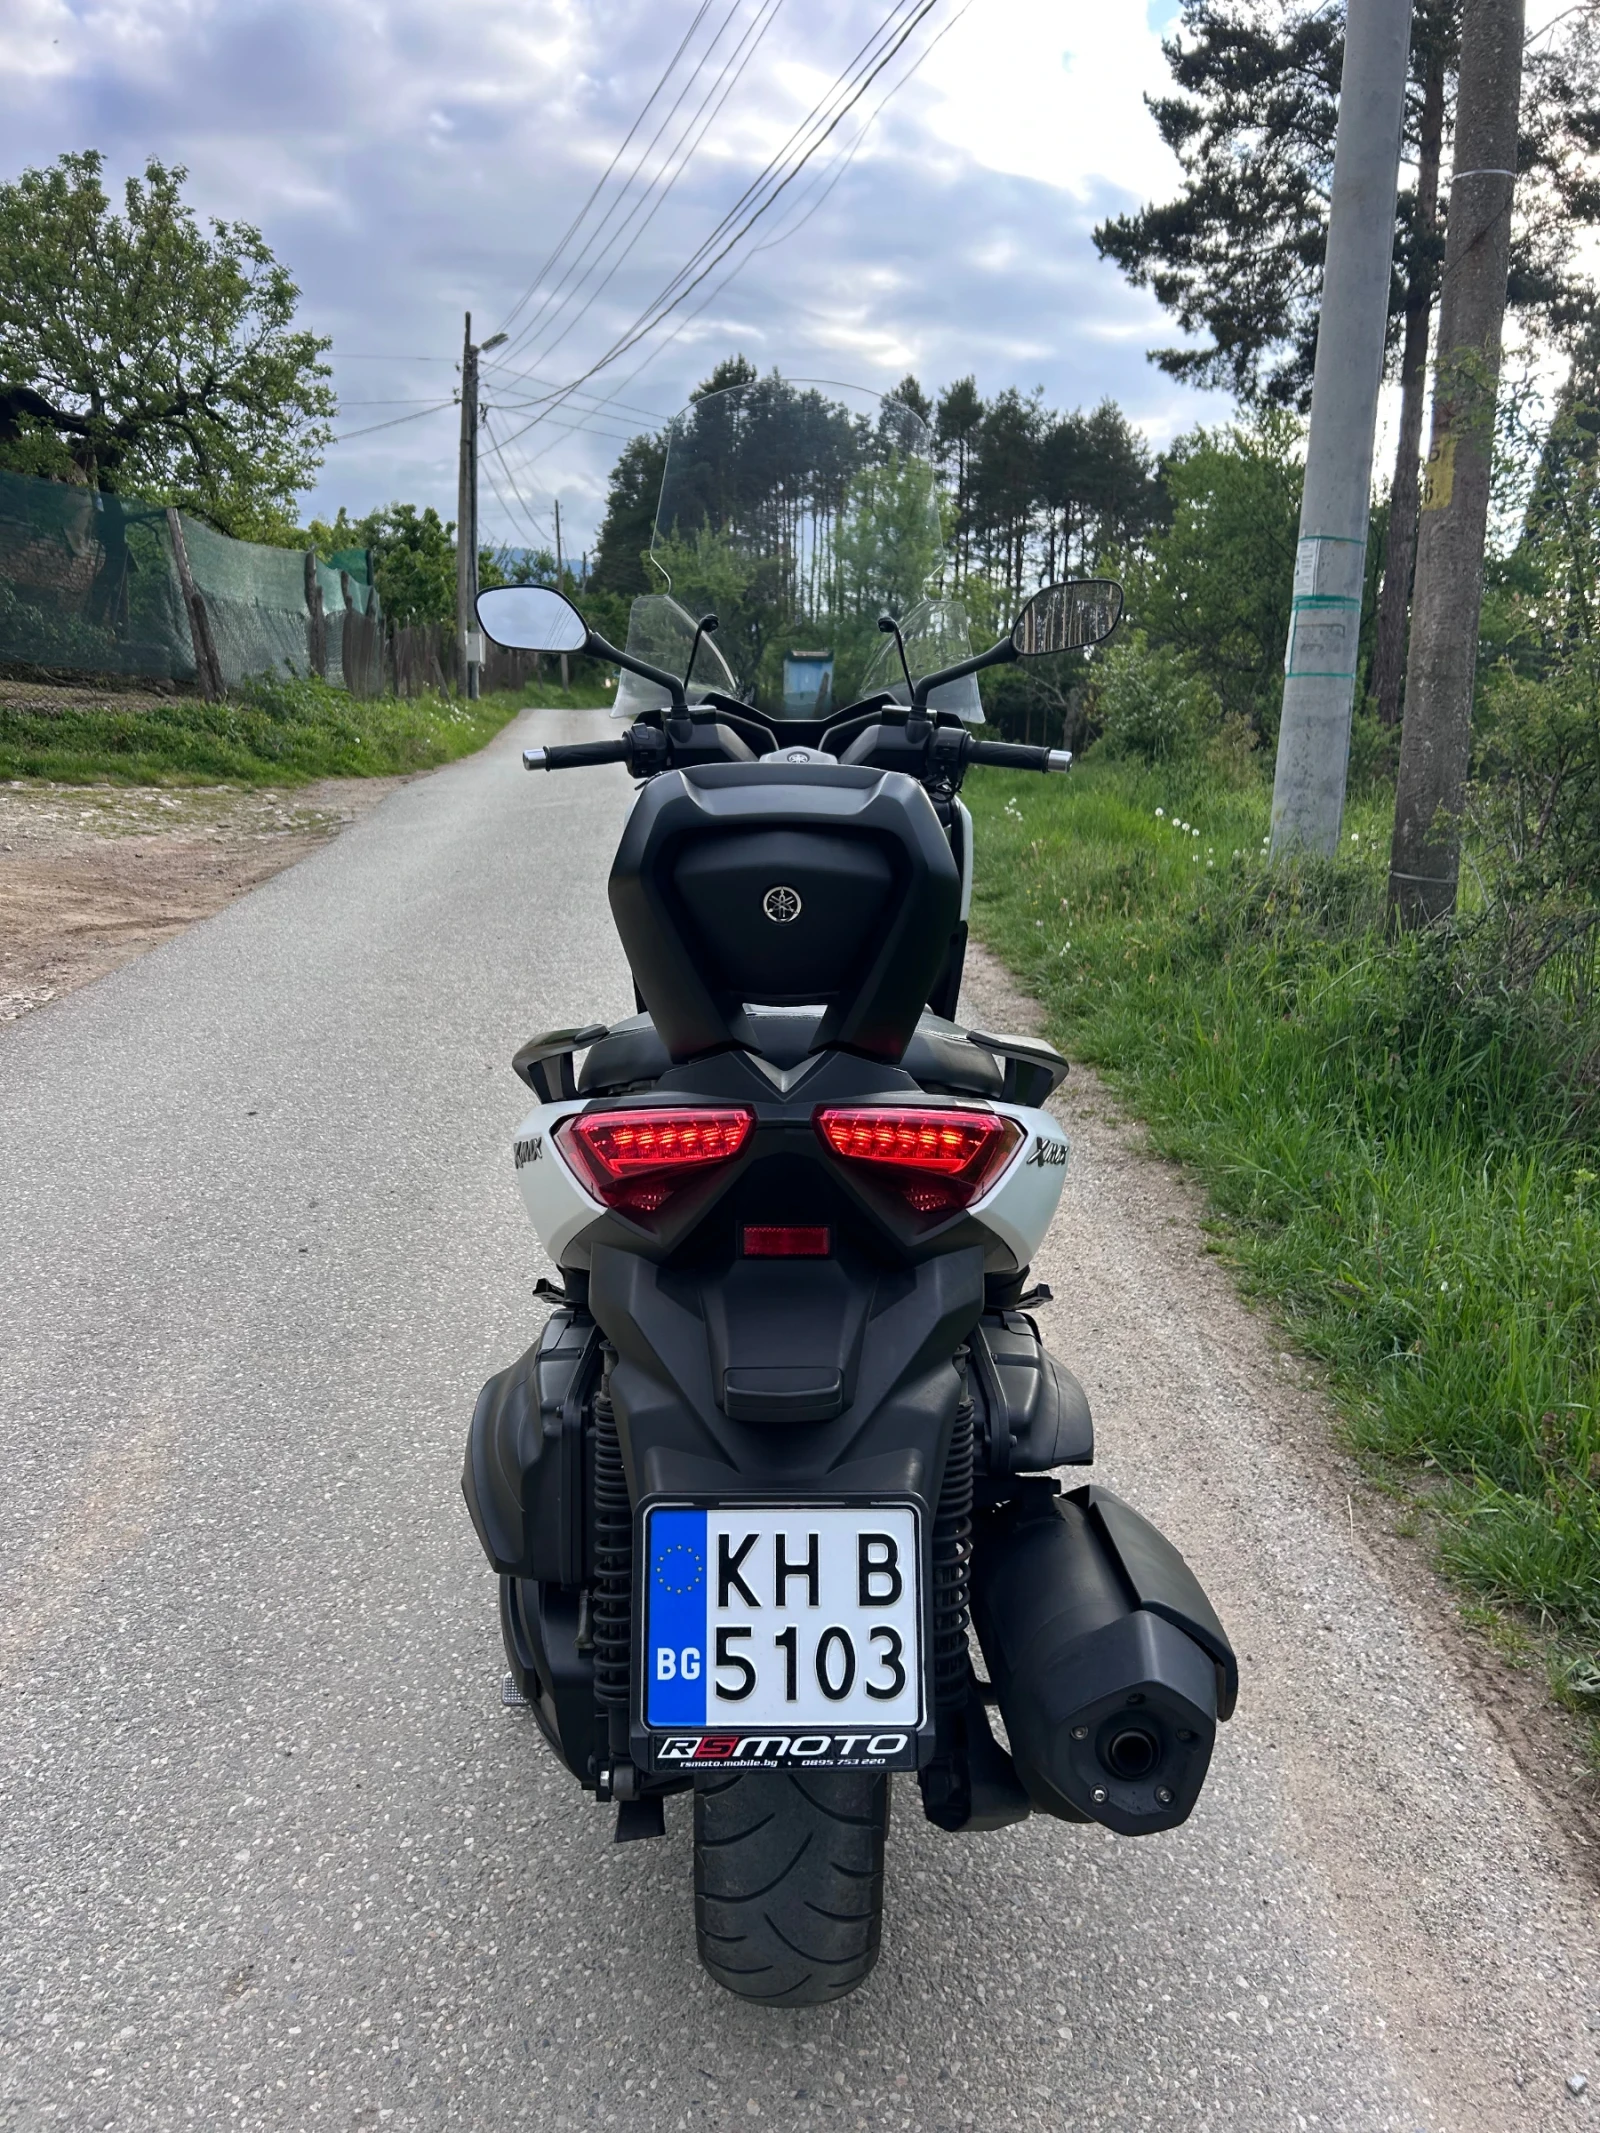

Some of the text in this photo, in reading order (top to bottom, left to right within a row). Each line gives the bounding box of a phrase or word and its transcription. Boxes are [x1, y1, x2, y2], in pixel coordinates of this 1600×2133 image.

[717, 1532, 903, 1608] KH B
[656, 1647, 701, 1681] BG
[715, 1625, 907, 1702] 5103
[680, 1757, 886, 1768] rsmoto.mobile.bg 0895 753 220
